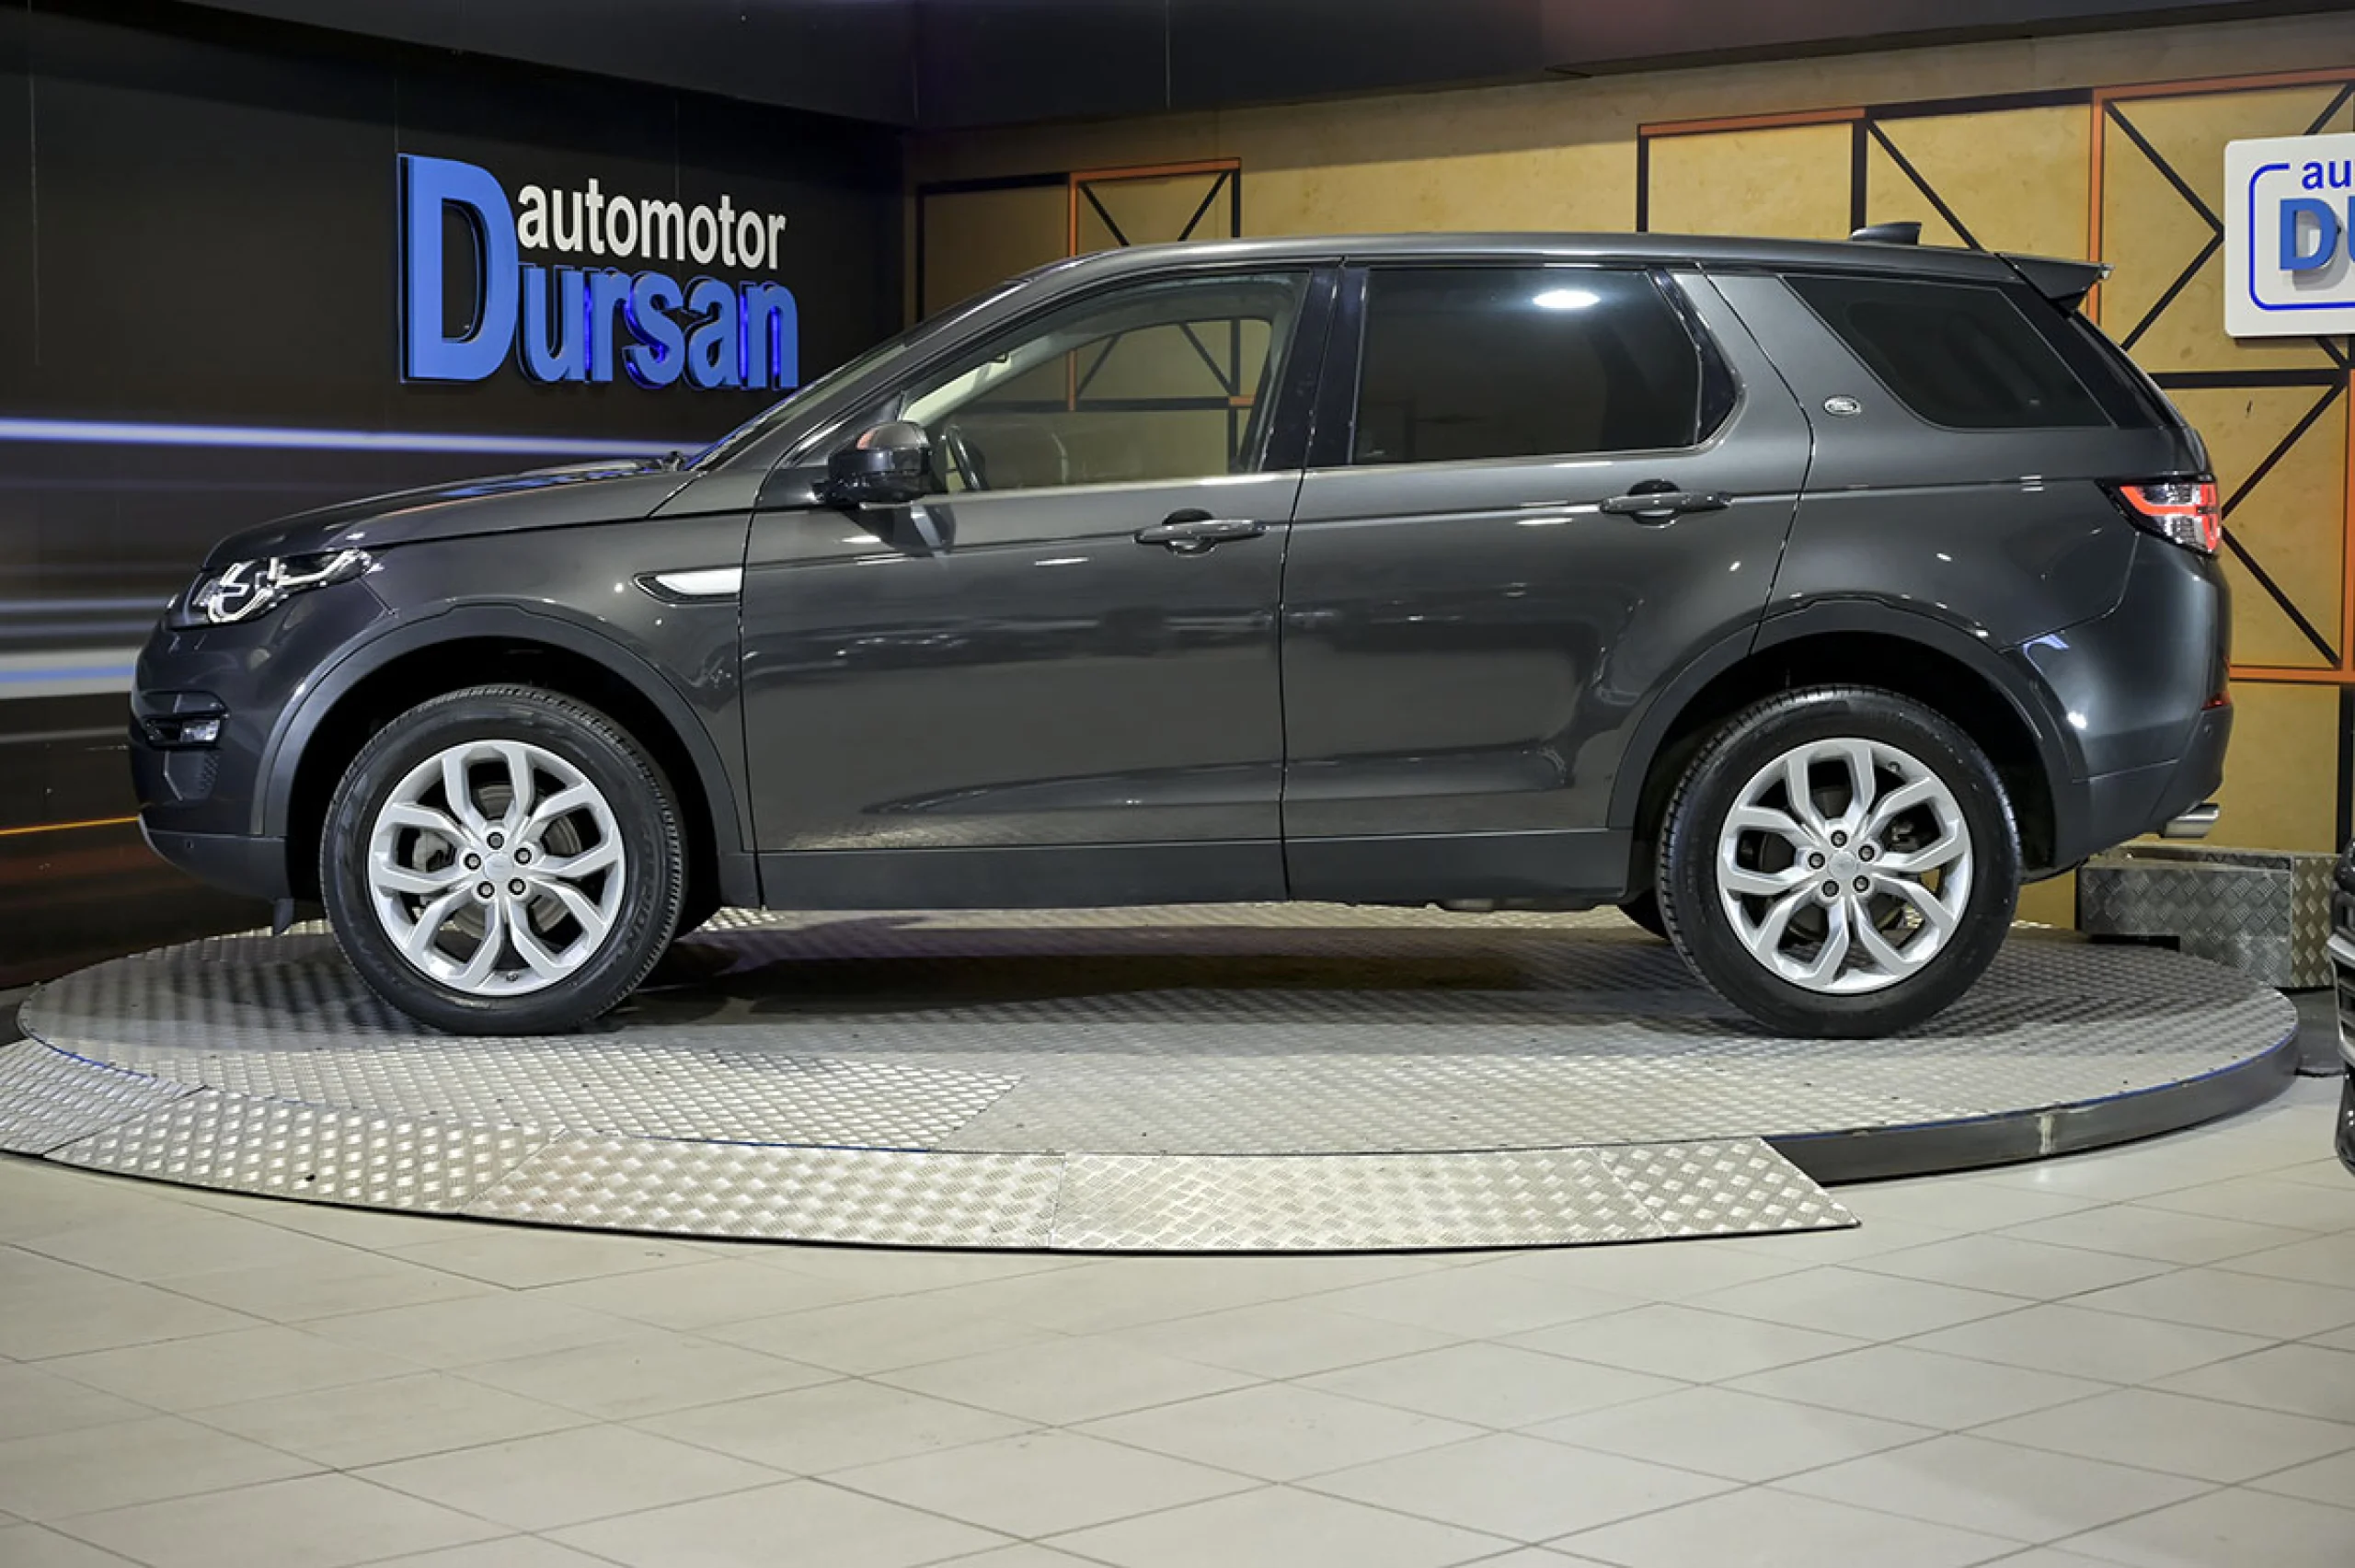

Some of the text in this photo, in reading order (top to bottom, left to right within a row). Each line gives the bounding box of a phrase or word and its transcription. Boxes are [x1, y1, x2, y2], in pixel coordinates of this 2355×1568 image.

[517, 177, 786, 269] automotor
[2278, 195, 2355, 271] D
[397, 153, 799, 389] Dursan
